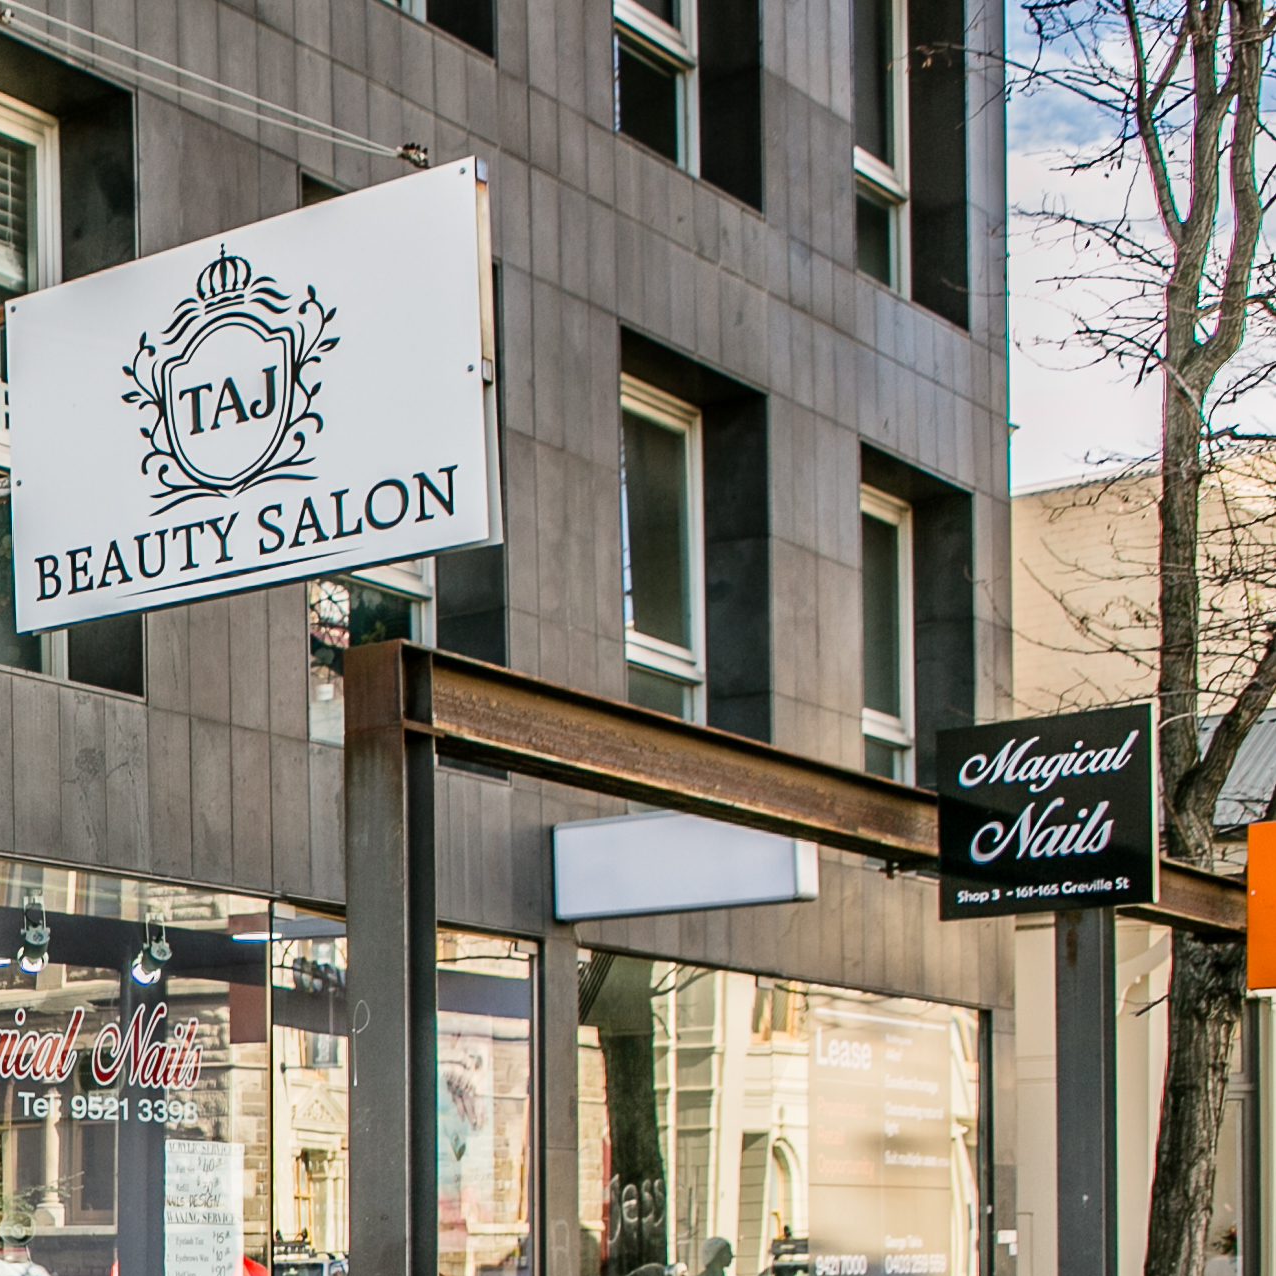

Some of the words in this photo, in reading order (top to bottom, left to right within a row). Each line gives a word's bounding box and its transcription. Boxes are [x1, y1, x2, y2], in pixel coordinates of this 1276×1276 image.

[178, 365, 279, 436] TAJ
[34, 511, 240, 603] BEAUTY
[257, 464, 459, 556] SALON
[958, 729, 1140, 794] Magical
[969, 797, 1114, 865] Nails
[957, 888, 990, 905] Shop
[992, 888, 1001, 901] 3
[1015, 884, 1059, 900] 161-165
[1061, 878, 1113, 895] Greville
[1115, 876, 1130, 890] St
[92, 1002, 204, 1091] Nails
[815, 1026, 873, 1071] Lease
[71, 1095, 129, 1121] 9521
[137, 1098, 199, 1124] 3398
